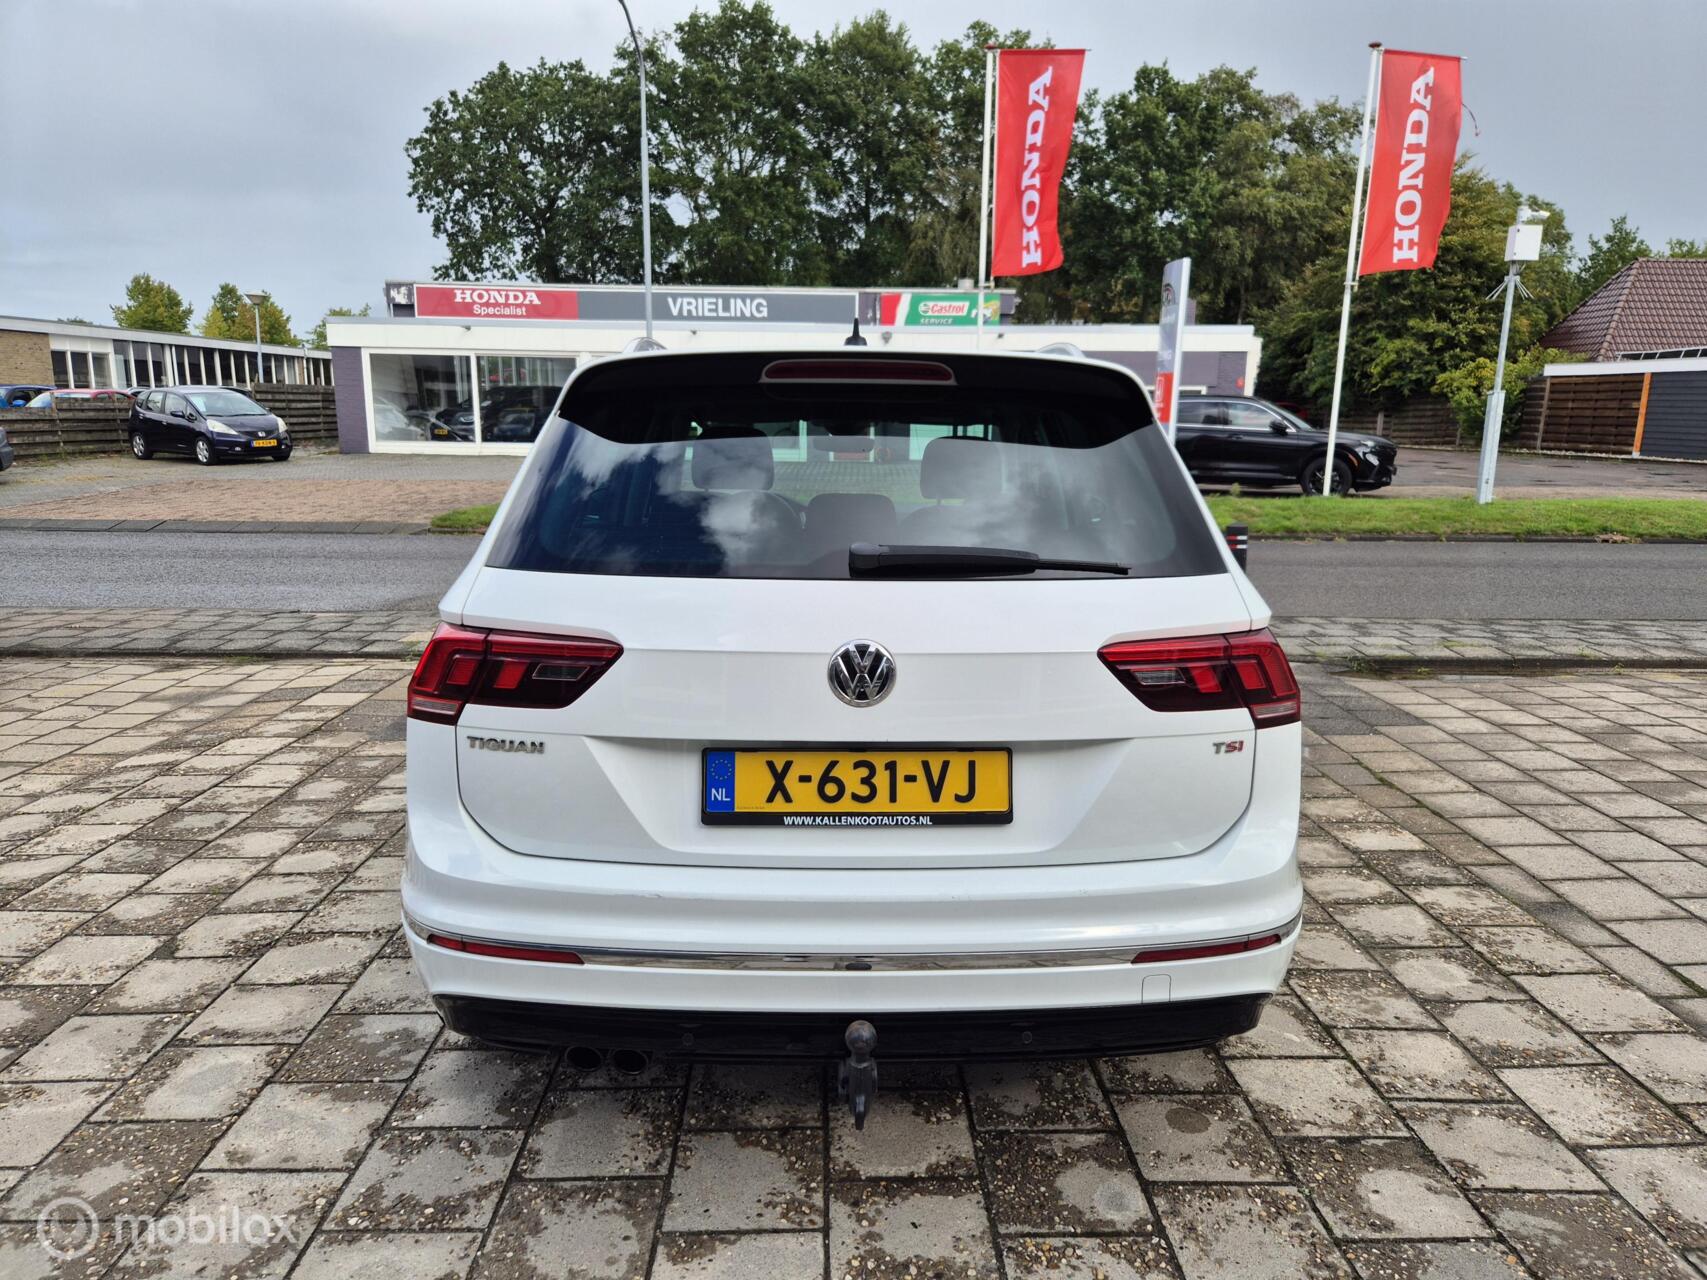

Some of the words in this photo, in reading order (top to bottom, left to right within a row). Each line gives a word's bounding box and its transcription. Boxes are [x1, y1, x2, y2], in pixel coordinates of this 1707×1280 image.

[1021, 66, 1053, 268] HONDA
[1393, 66, 1435, 263] HONDA
[453, 288, 542, 305] HONDA
[473, 304, 527, 316] Specialist
[667, 297, 769, 319] VRIELING
[930, 303, 966, 315] Castrol
[466, 735, 545, 755] TIGUAN
[711, 788, 731, 801] NL
[765, 759, 977, 804] X-631-VJ
[783, 815, 933, 826] WWW.KALLENKOOTAUTOS.NL
